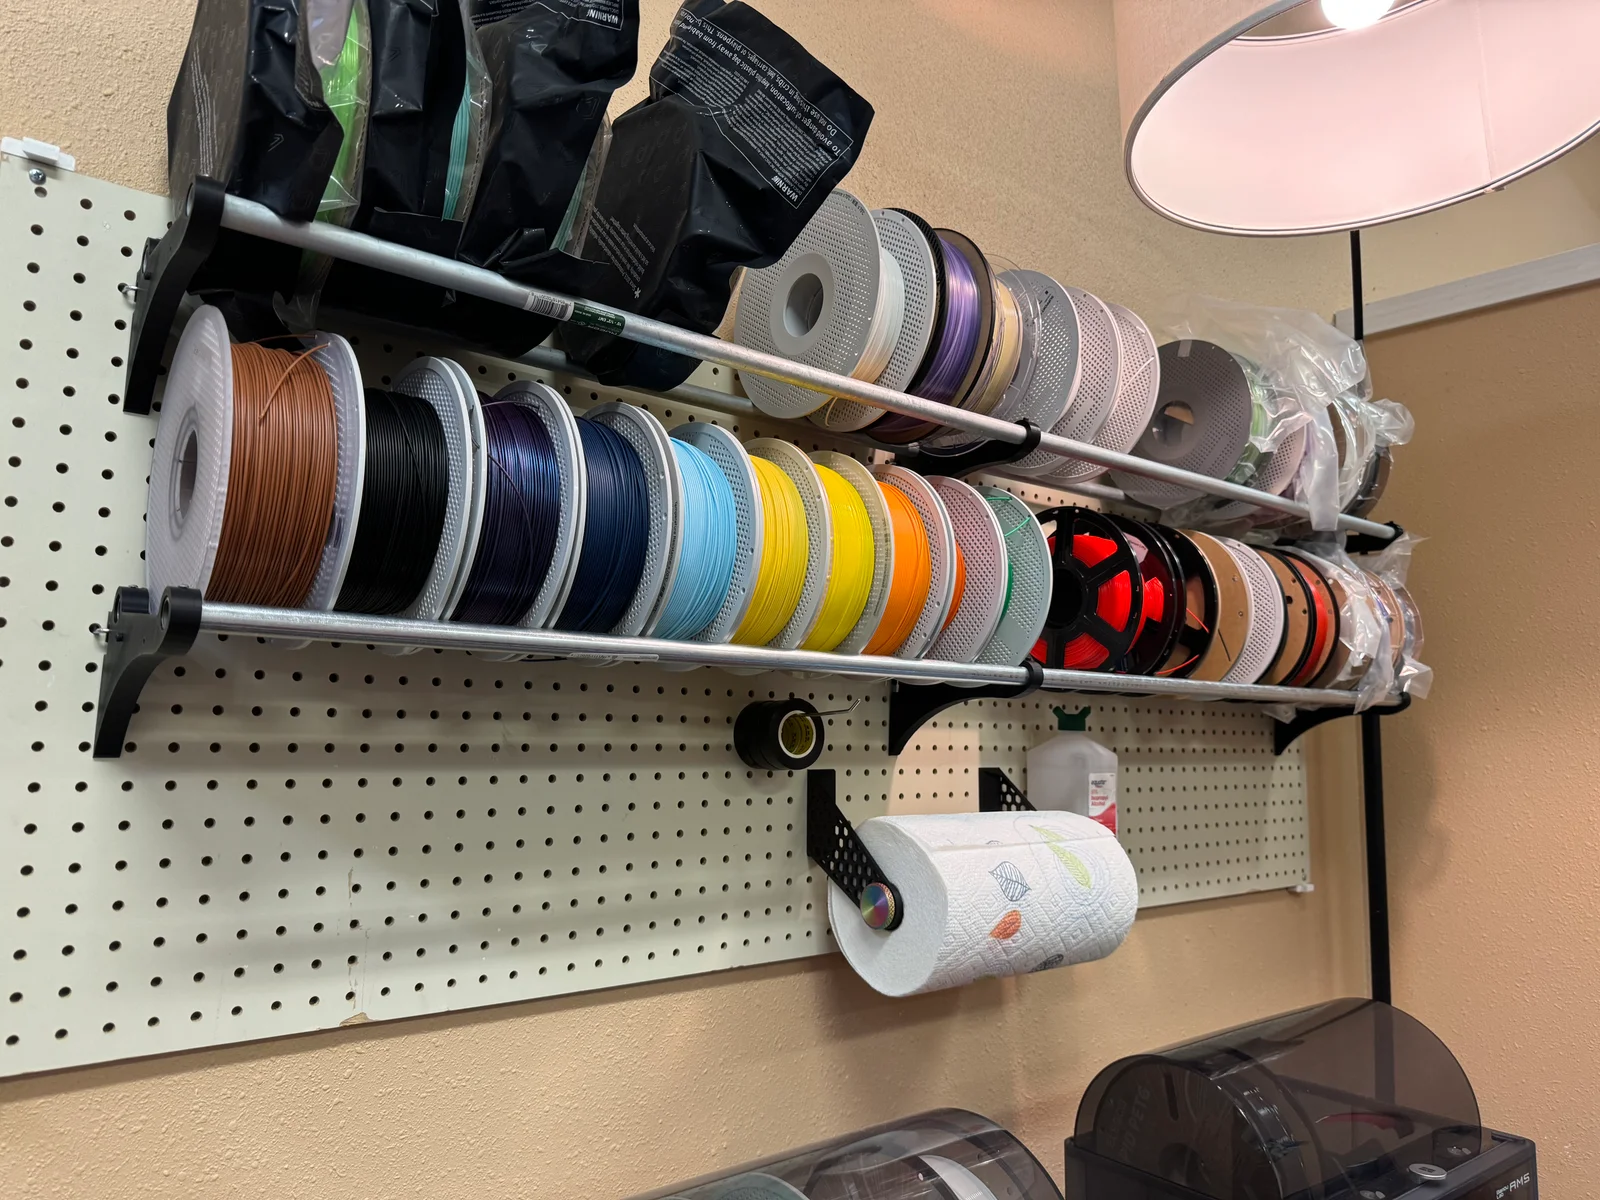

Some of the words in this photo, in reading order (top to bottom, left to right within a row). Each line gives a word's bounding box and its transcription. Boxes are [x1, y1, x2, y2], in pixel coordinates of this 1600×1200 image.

[700, 21, 716, 35] This
[702, 34, 718, 49] from
[714, 29, 742, 52] playpens.
[716, 42, 733, 59] away
[739, 47, 748, 56] or
[730, 53, 742, 65] bag
[739, 61, 758, 77] plastic
[773, 74, 790, 92] cribs,
[787, 88, 796, 98] in
[794, 111, 802, 120] of
[810, 108, 821, 119] use
[825, 123, 837, 137] Do
[815, 130, 833, 147] avoid
[831, 144, 842, 156] To
[1126, 1084, 1153, 1132] PETG
[1510, 1172, 1530, 1192] AMS
